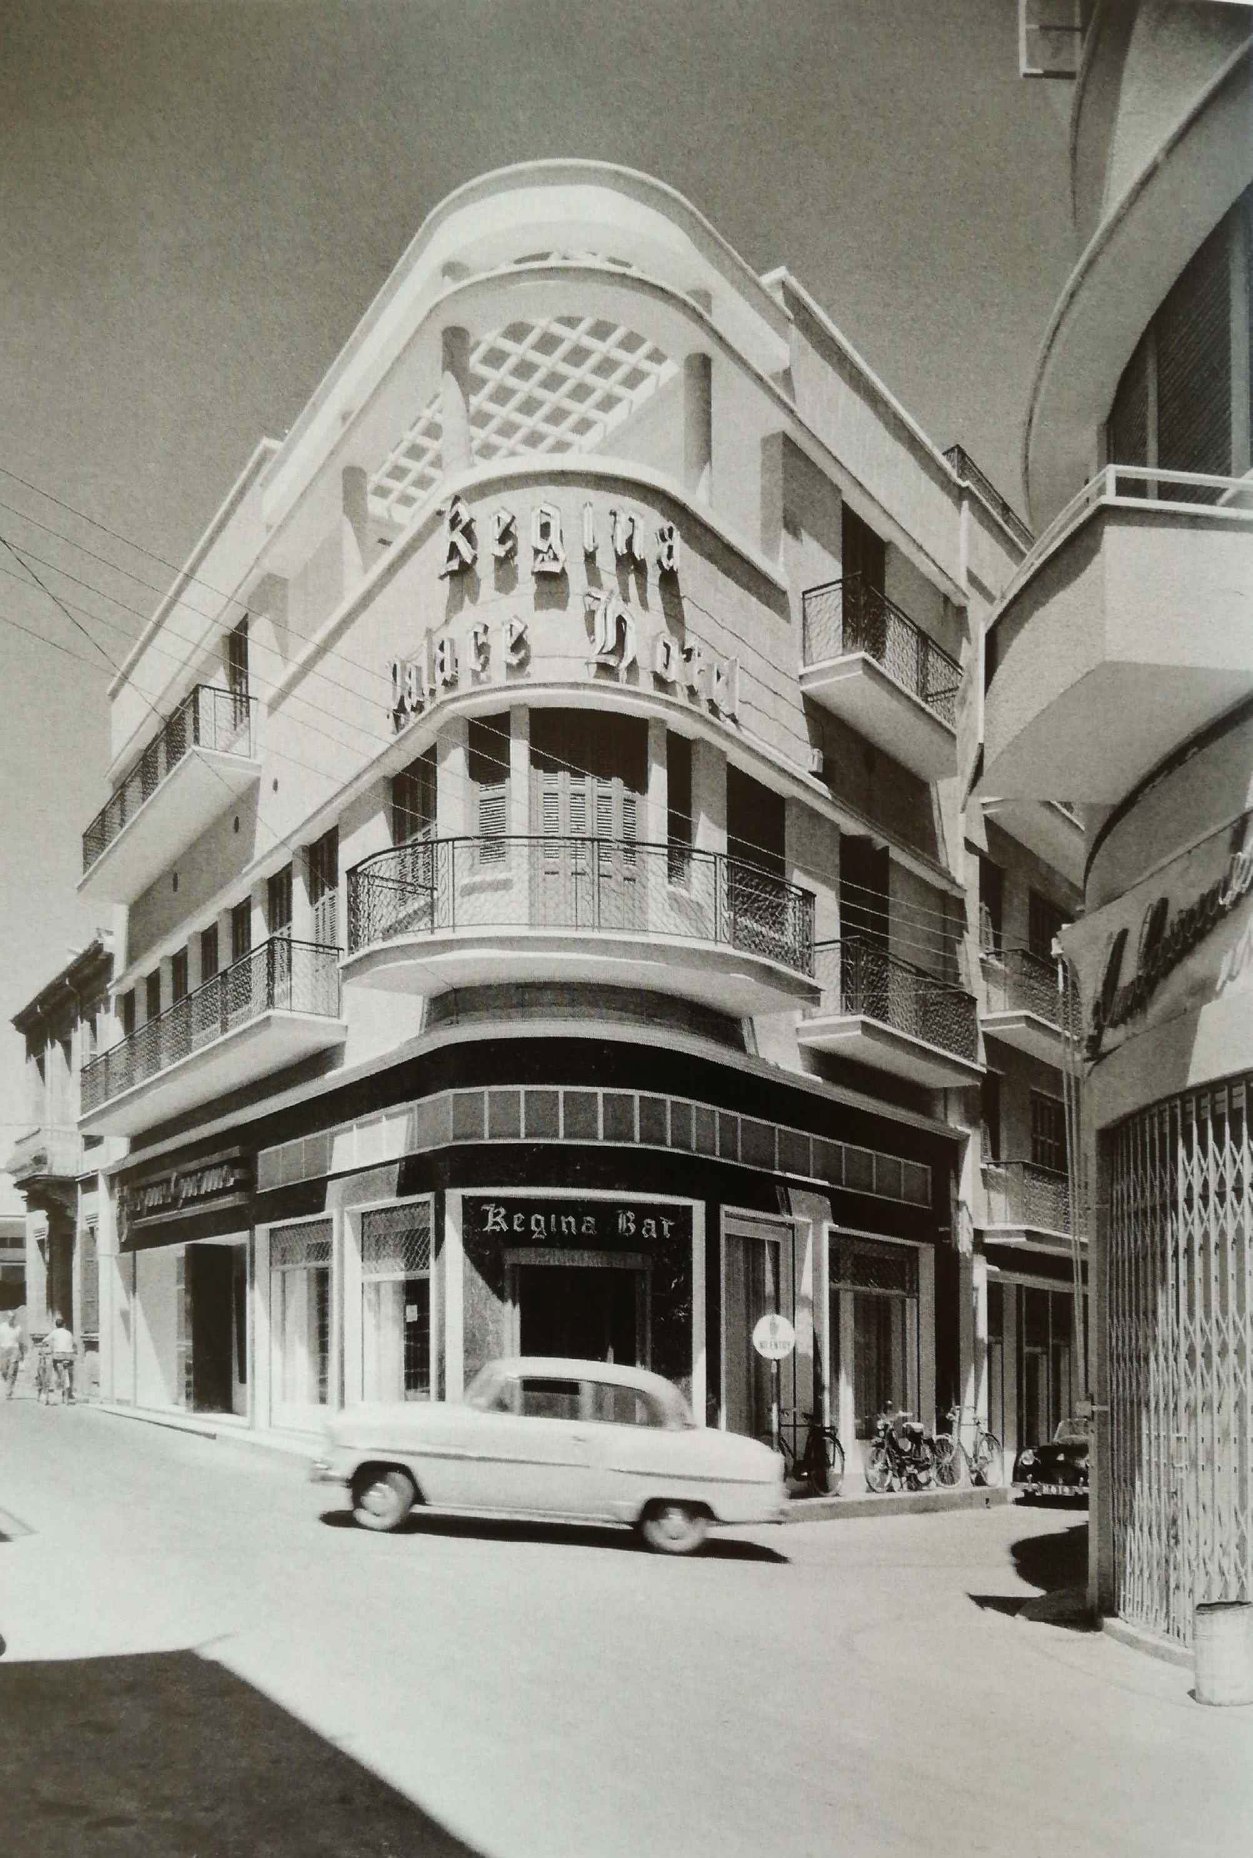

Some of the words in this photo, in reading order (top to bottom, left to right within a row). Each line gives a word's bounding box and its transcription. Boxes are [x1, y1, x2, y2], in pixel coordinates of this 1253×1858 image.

[440, 495, 680, 579] Regina
[481, 1203, 597, 1240] Regina
[616, 1209, 675, 1239] Bar
